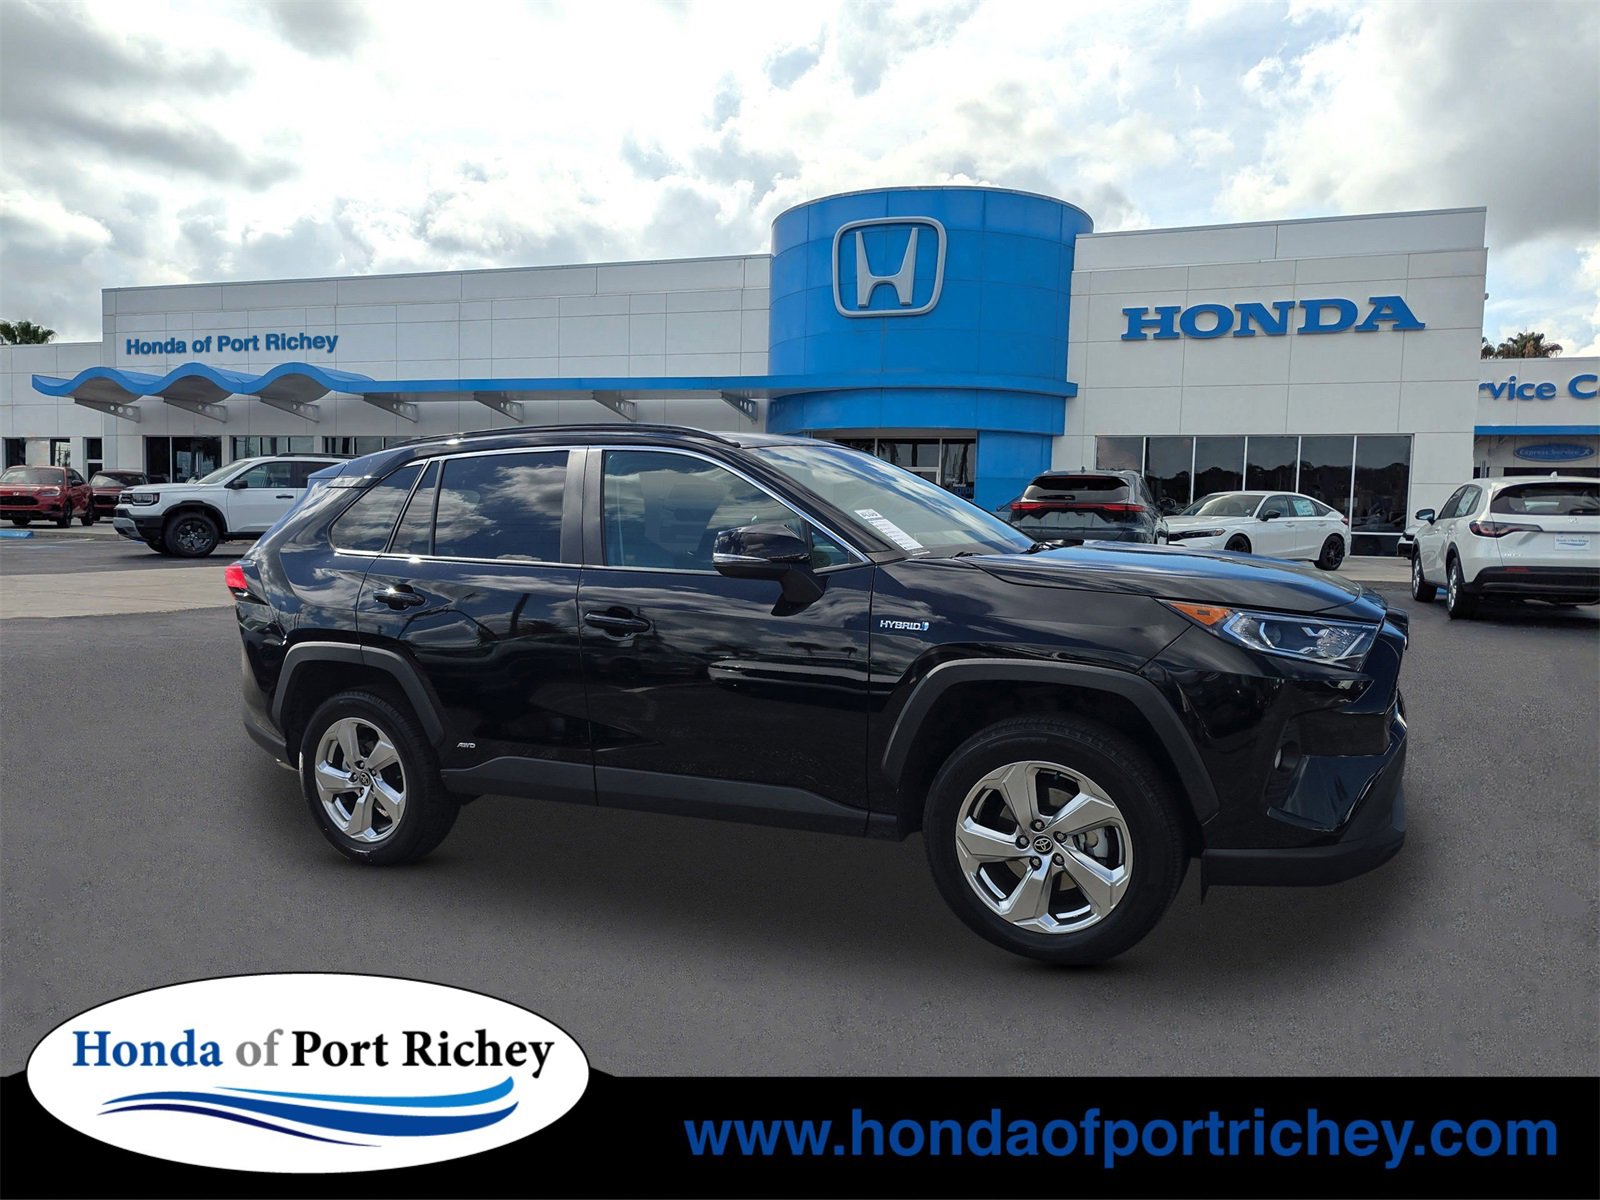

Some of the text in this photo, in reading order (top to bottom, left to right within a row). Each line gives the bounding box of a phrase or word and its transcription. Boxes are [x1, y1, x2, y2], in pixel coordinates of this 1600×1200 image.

[1120, 295, 1426, 341] HONDA
[125, 332, 339, 355] Honda of Port Richey
[1567, 373, 1600, 400] C
[879, 619, 921, 631] HYBRID
